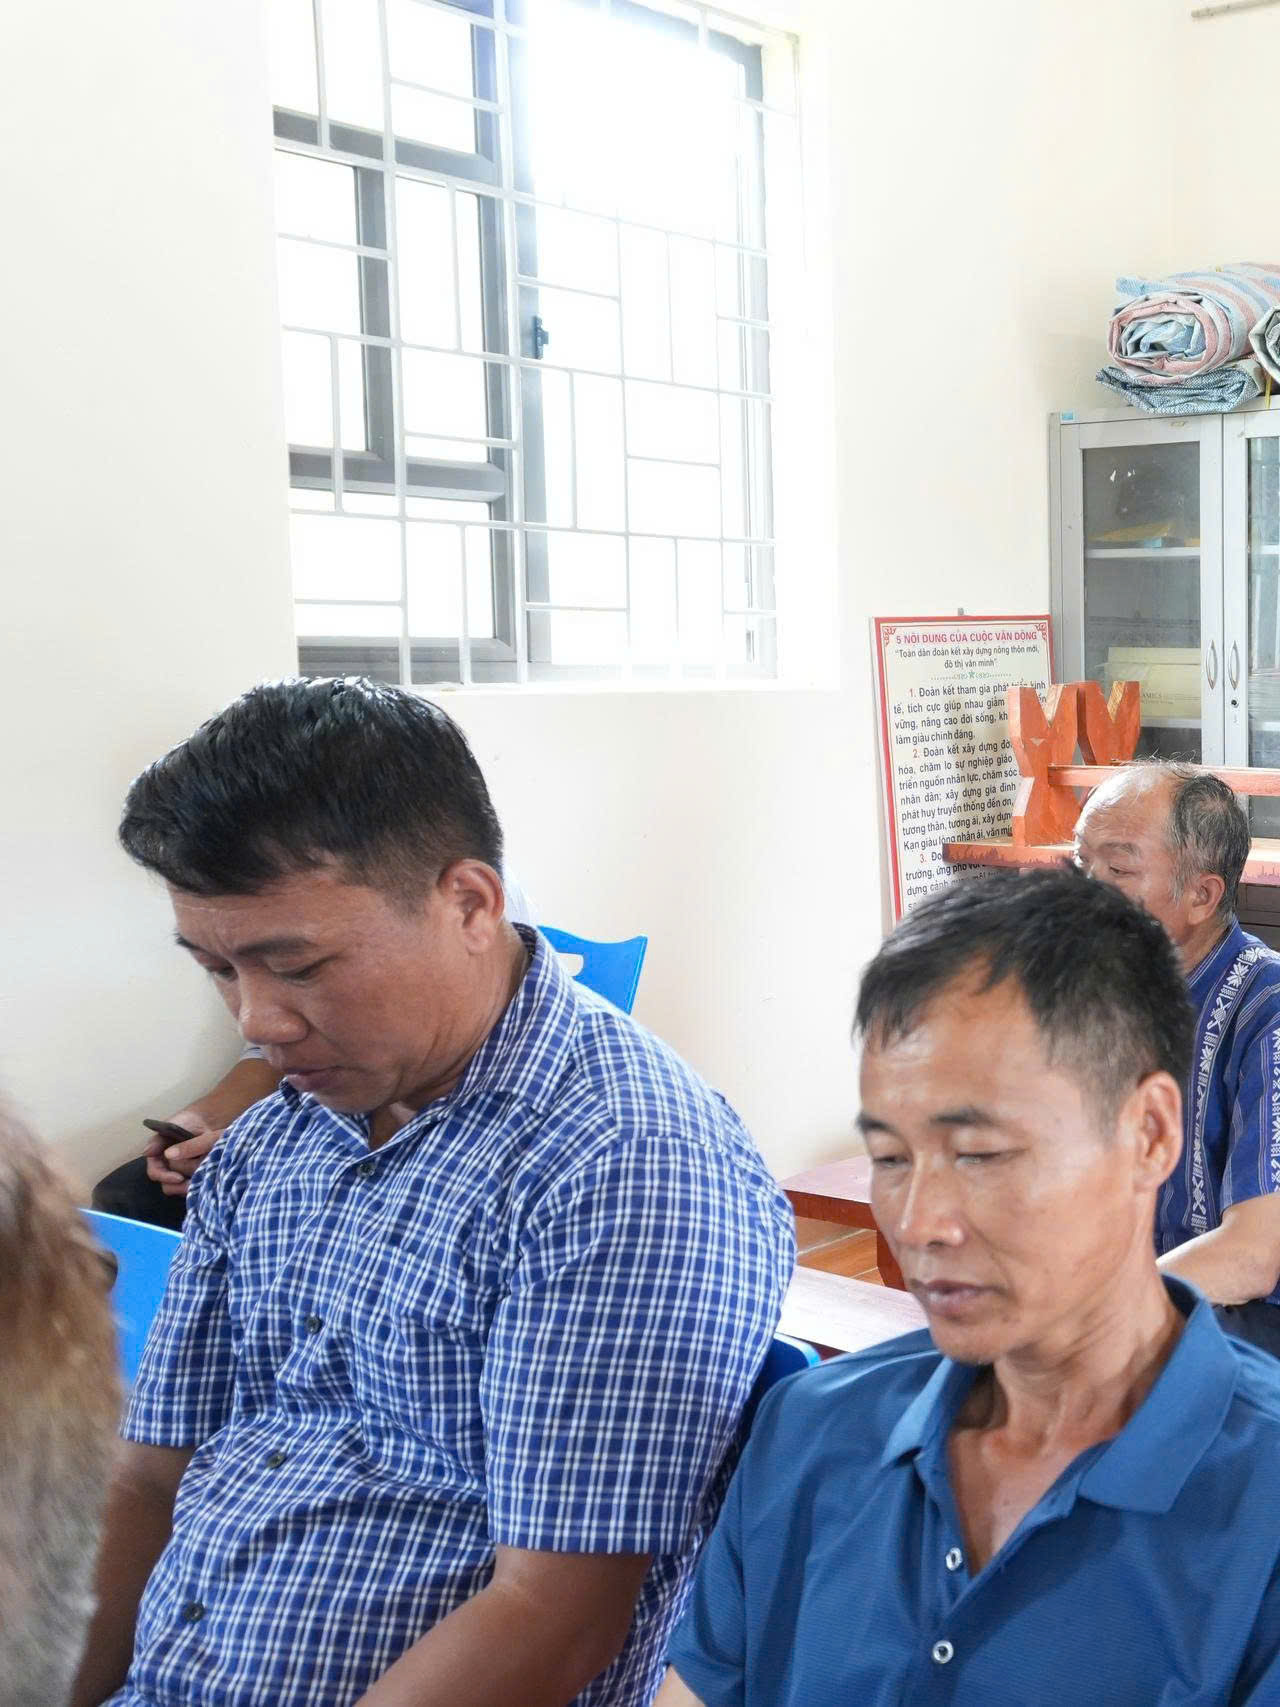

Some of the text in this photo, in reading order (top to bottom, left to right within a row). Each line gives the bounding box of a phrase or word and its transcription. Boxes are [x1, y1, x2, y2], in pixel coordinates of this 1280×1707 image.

[896, 629, 1037, 647] 5 NỘI DUNG CỦA CUỘC VẬN ĐỘNG
[917, 647, 931, 657] dân
[932, 647, 949, 657] đoàn
[950, 645, 961, 656] kết
[962, 646, 974, 657] xây
[975, 646, 992, 657] dựng
[993, 645, 1010, 656] nông
[1010, 644, 1026, 654] thôn
[909, 687, 917, 698] 1.
[919, 686, 940, 697] Đoàn
[942, 684, 955, 696] kết
[957, 684, 977, 696] tham
[978, 684, 991, 696] gia
[907, 701, 923, 713] tích
[926, 703, 941, 714] cực
[944, 699, 962, 713] giúp
[964, 699, 983, 710] nhau
[986, 696, 1005, 709] giảm
[921, 716, 941, 729] nâng
[944, 717, 958, 725] cao
[960, 713, 973, 724] đời
[896, 734, 911, 745] làm
[912, 732, 930, 746] giàu
[930, 730, 953, 742] chính
[923, 746, 945, 758] Đoàn
[947, 743, 959, 755] kết
[962, 742, 976, 755] xây
[978, 741, 998, 754] dựng
[944, 760, 953, 771] lo
[955, 760, 965, 771] sự
[967, 757, 994, 770] nghiệp
[996, 753, 1013, 767] giáo
[899, 775, 918, 791] triển
[919, 775, 945, 790] nguồn
[946, 773, 966, 785] nhân
[982, 770, 1003, 782] chăm
[1003, 768, 1018, 779] sóc
[900, 793, 921, 805] nhân
[945, 788, 960, 801] xây
[962, 786, 982, 799] dựng
[985, 784, 997, 797] gia
[999, 782, 1016, 793] đình
[901, 809, 920, 824] phát
[921, 808, 936, 819] huy
[937, 801, 962, 817] truyền
[963, 799, 986, 812] thống
[986, 796, 1001, 809] đền
[902, 823, 926, 836] tương
[948, 816, 971, 830] tương
[982, 812, 996, 825] xây
[903, 839, 920, 853] Kạn
[920, 837, 938, 851] giàu
[956, 830, 977, 842] nhân
[985, 826, 1001, 838] văn
[936, 864, 951, 877] ứng
[907, 884, 928, 897] dựng
